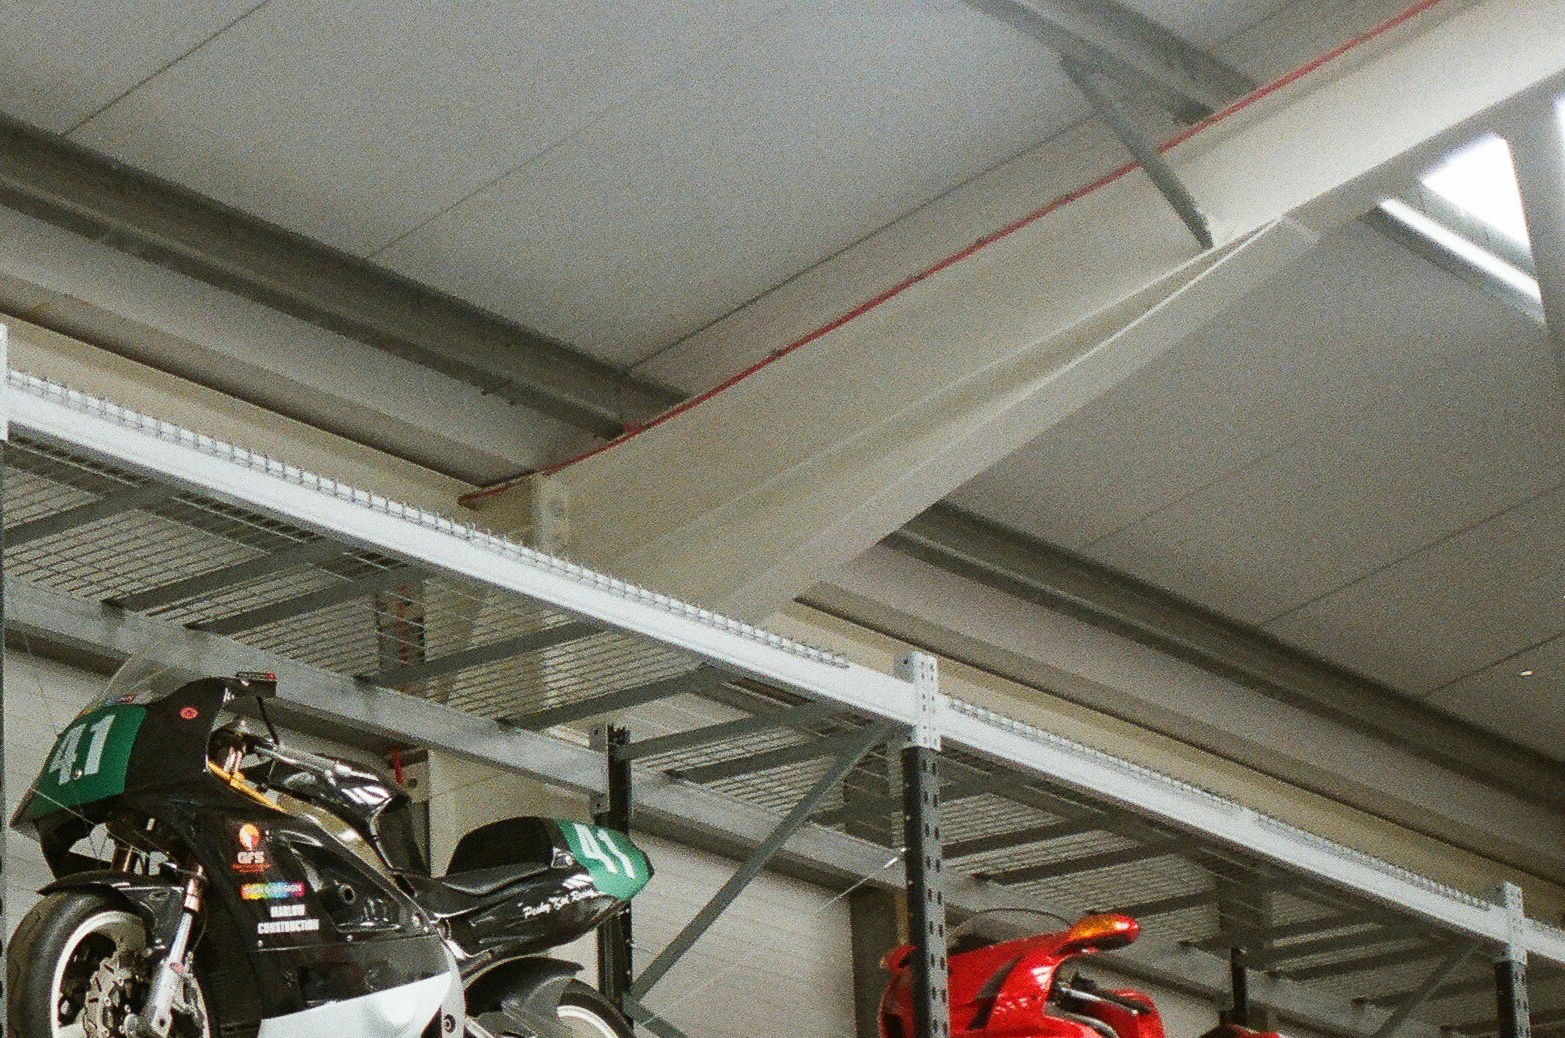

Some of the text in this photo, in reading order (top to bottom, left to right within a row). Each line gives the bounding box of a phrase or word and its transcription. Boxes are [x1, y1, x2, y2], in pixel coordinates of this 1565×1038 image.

[49, 714, 116, 785] 41
[573, 822, 636, 879] 41
[257, 919, 319, 934] CONSTRUCTION
